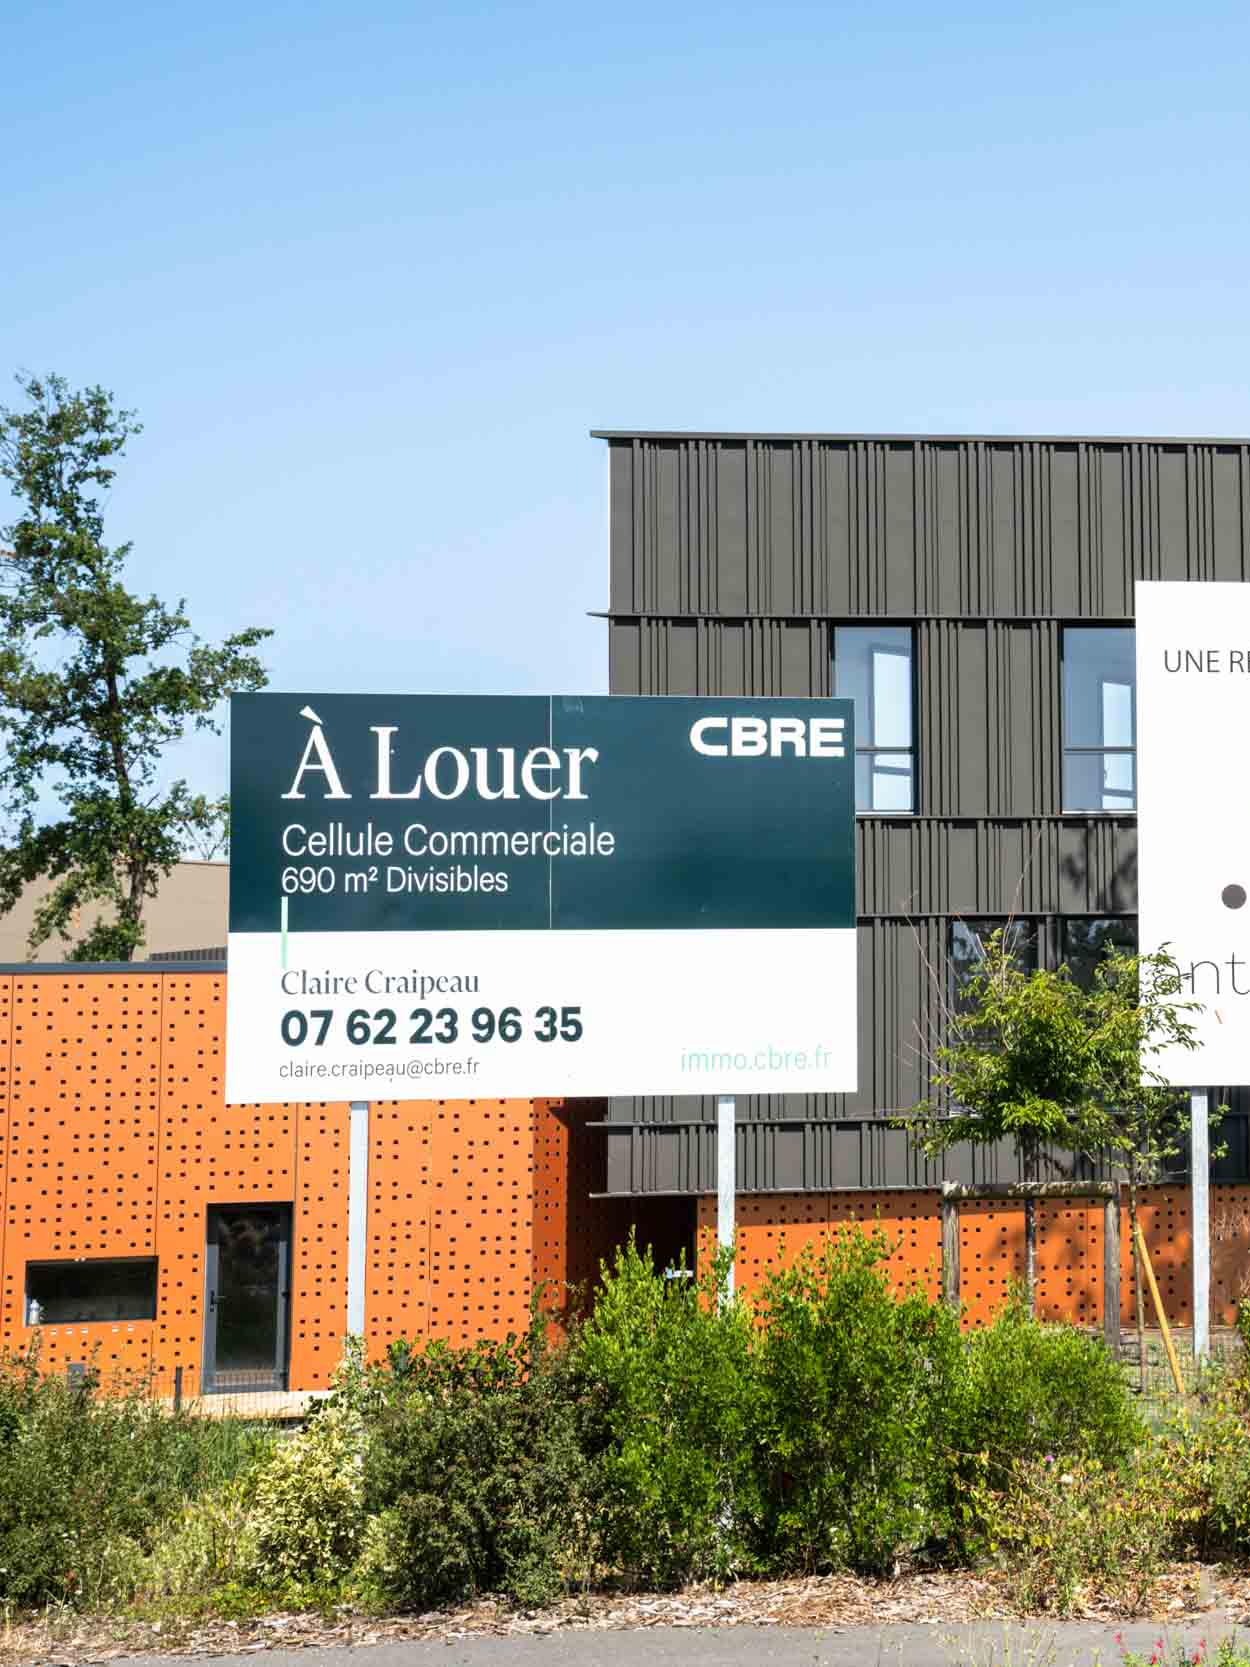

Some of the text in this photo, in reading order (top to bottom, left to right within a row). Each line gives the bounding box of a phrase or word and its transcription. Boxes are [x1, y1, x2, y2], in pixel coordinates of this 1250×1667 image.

[1163, 649, 1220, 674] UNE
[281, 705, 598, 801] À Louer
[689, 717, 845, 758] CBRE
[281, 823, 615, 857] Cellule Commerciale
[281, 866, 336, 894] 690
[386, 865, 509, 893] Divisibles
[281, 968, 480, 999] Claire Craipeau
[280, 1005, 584, 1047] 07 62 23 96 35
[279, 1056, 480, 1081] claire.craipeau@cbre.fr
[680, 1043, 832, 1073] immo.cbre.fr
